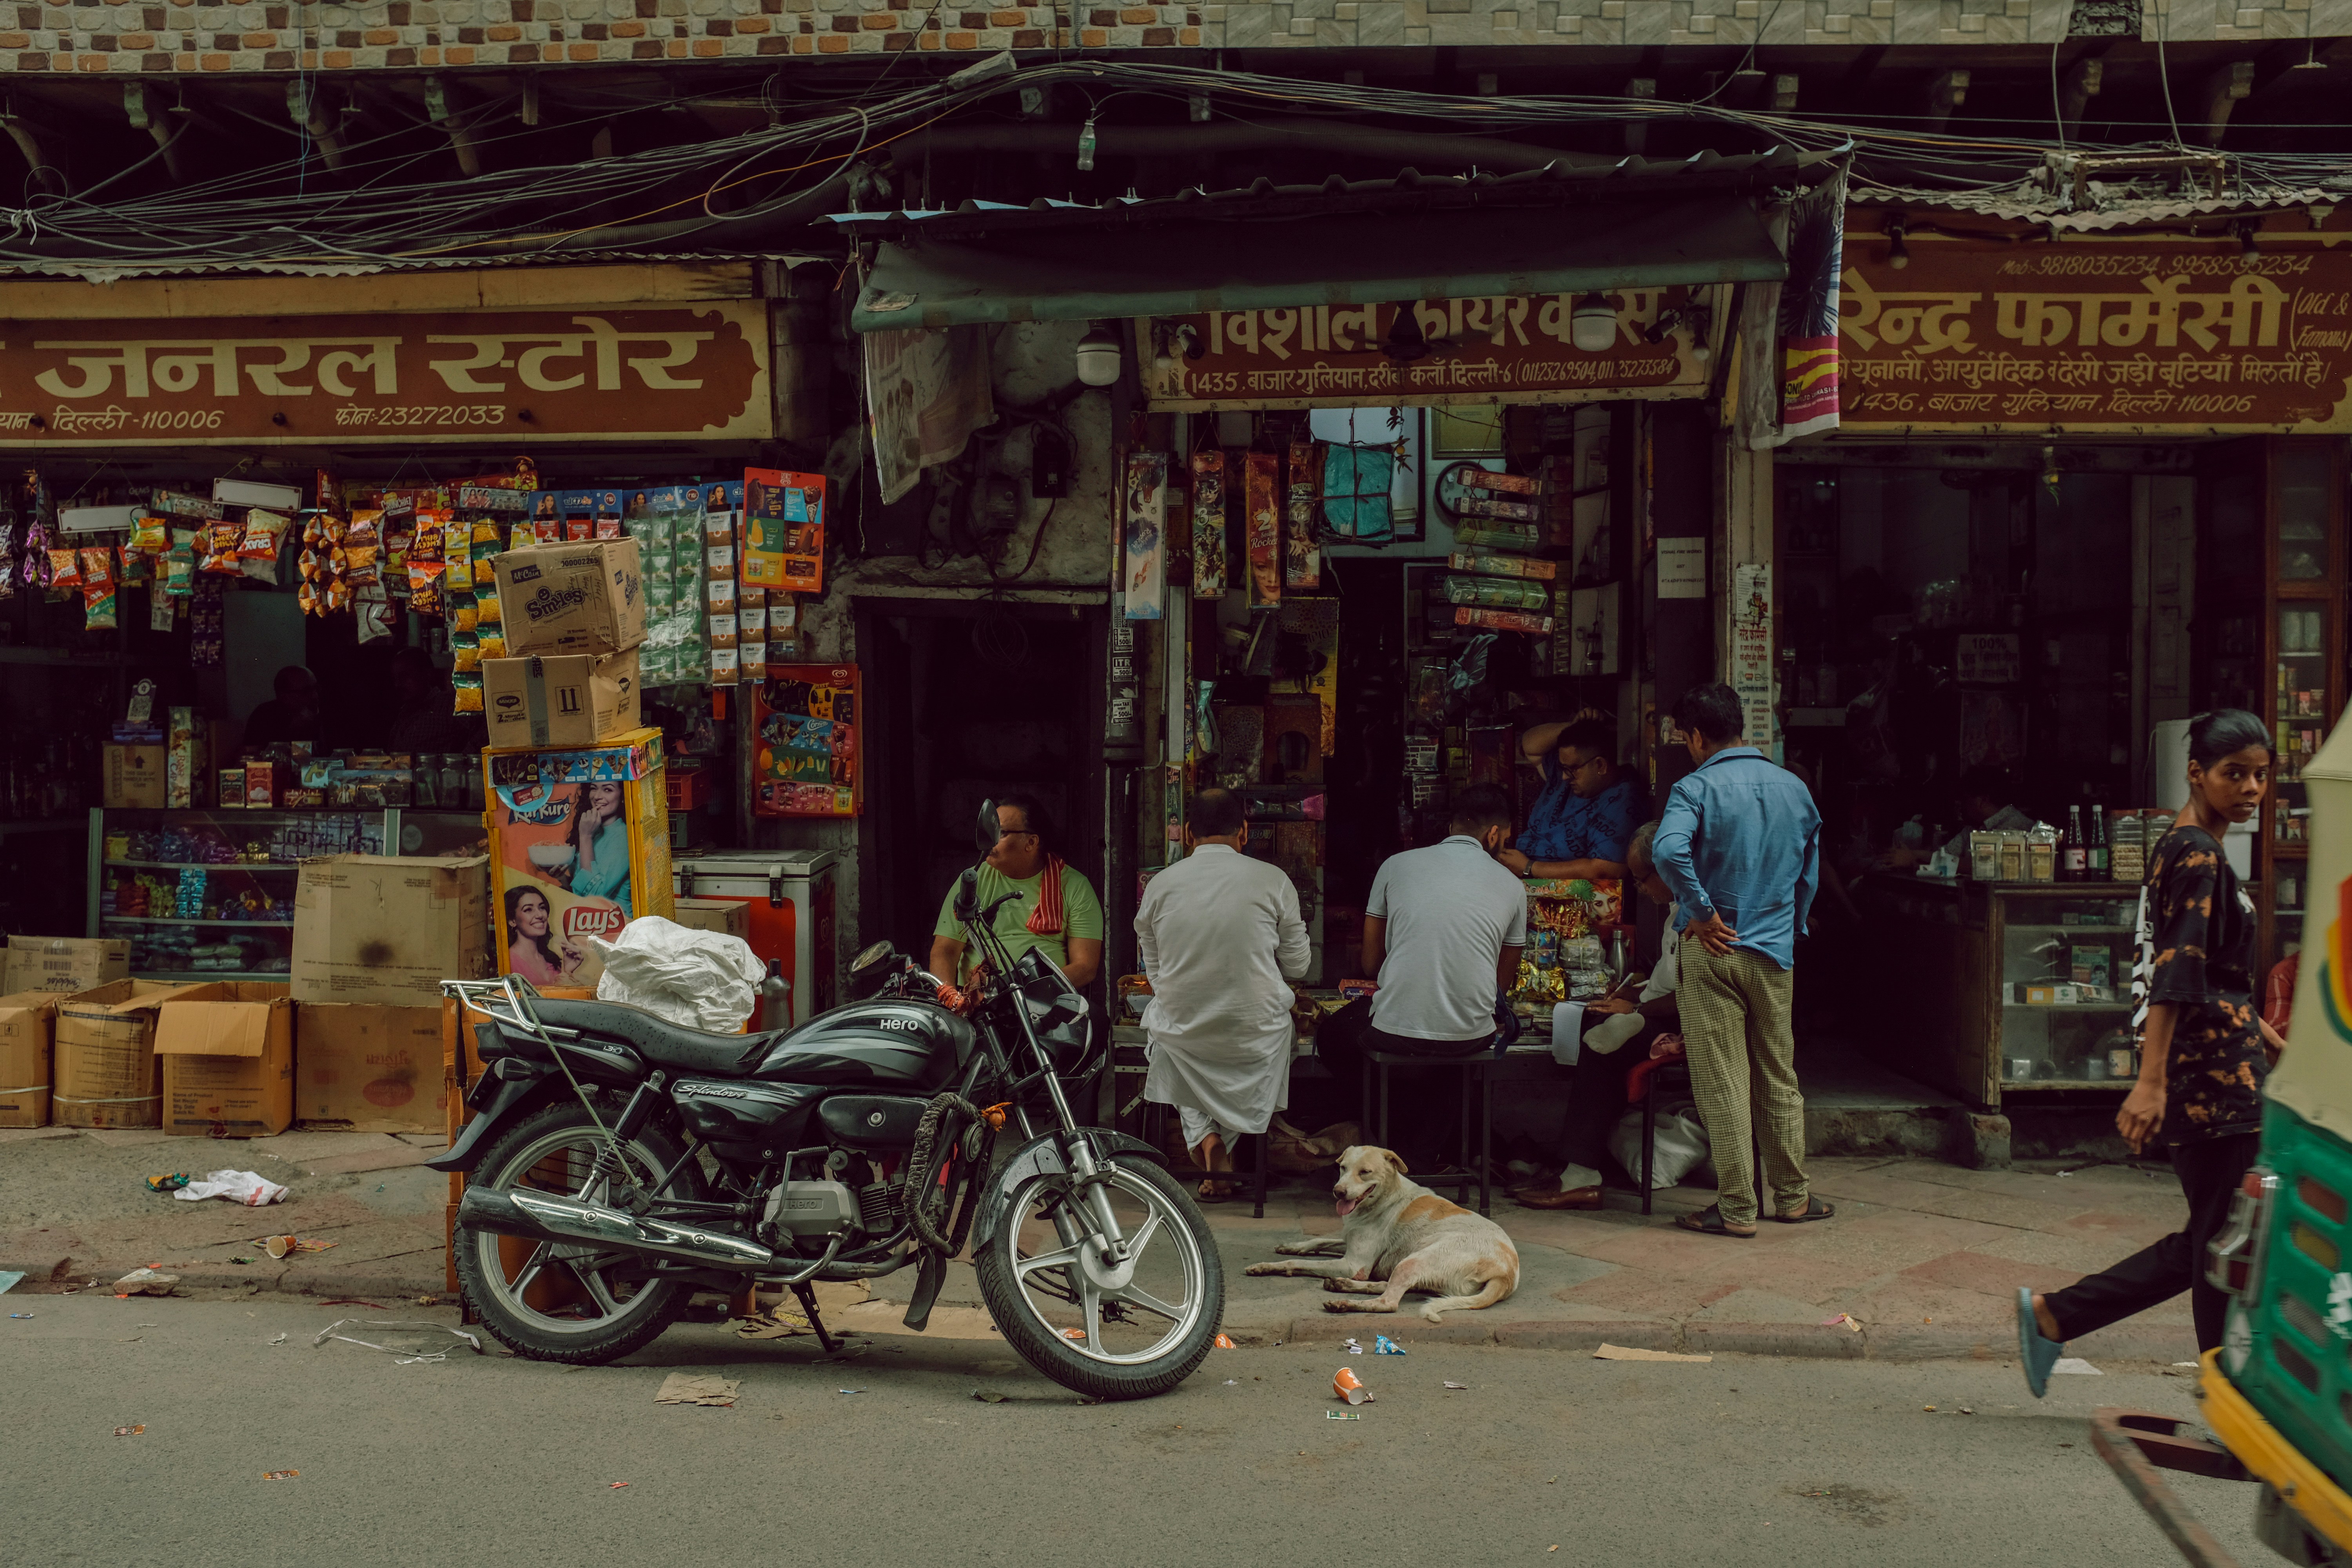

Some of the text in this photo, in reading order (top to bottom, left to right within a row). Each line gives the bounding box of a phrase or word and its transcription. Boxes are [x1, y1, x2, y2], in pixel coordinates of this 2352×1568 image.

[1839, 267, 1982, 353] रेन्द्र
[34, 316, 714, 399] जनरल स्टोर
[1247, 370, 1294, 391] बाजार
[1928, 393, 1997, 412] बाजार
[1256, 512, 1272, 531] 2
[244, 538, 271, 552] CRAX
[1251, 537, 1278, 549] Rocket
[89, 573, 107, 584] CRAX
[514, 570, 540, 581] McCain
[525, 586, 585, 621] Smiles
[1115, 658, 1131, 666] ITR
[567, 907, 621, 936] Lay's
[880, 1019, 919, 1031] Hero
[789, 1198, 818, 1209] Hero
